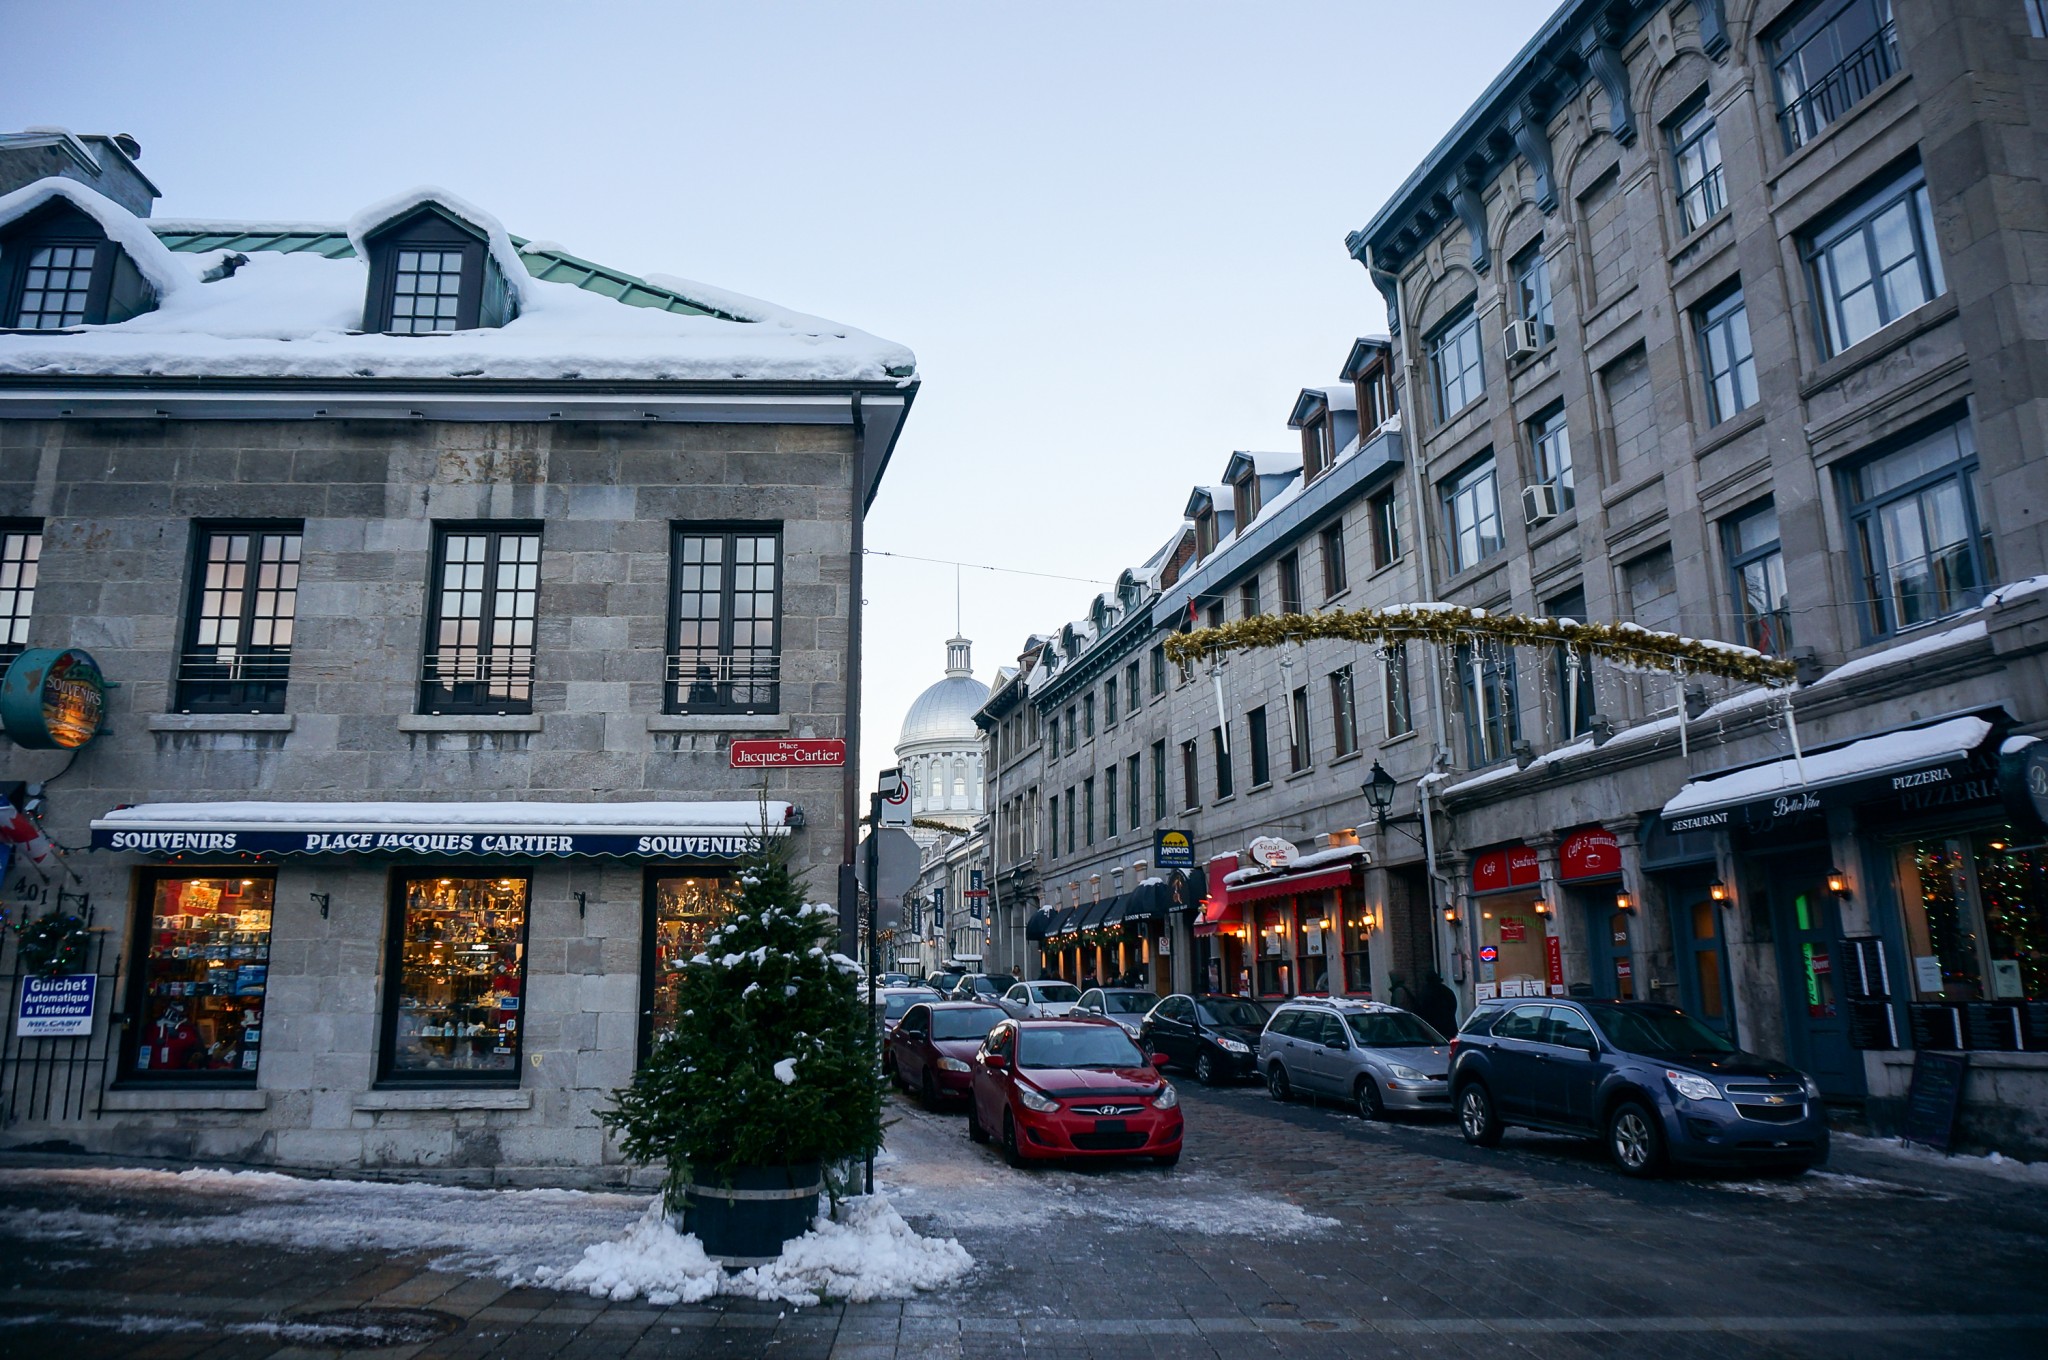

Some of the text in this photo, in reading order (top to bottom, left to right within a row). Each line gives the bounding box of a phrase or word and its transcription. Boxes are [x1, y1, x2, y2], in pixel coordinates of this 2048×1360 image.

[47, 674, 102, 706] SOUVENIRS
[779, 742, 798, 750] Place
[737, 749, 840, 766] Jacques-Cartier
[1892, 768, 1952, 790] PIZZERIA
[1773, 791, 1820, 817] Bella Vita
[1672, 812, 1729, 831] RESTAURANT
[111, 831, 237, 849] SOUVENIRS
[306, 833, 573, 851] PLACE JACQUES CARTIER
[638, 836, 761, 853] SOUVENIRS
[1583, 836, 1588, 847] 5
[14, 876, 48, 905] 401
[30, 978, 88, 992] Guichet
[24, 993, 90, 1004] Automatique
[35, 1004, 87, 1015] l'intérieur
